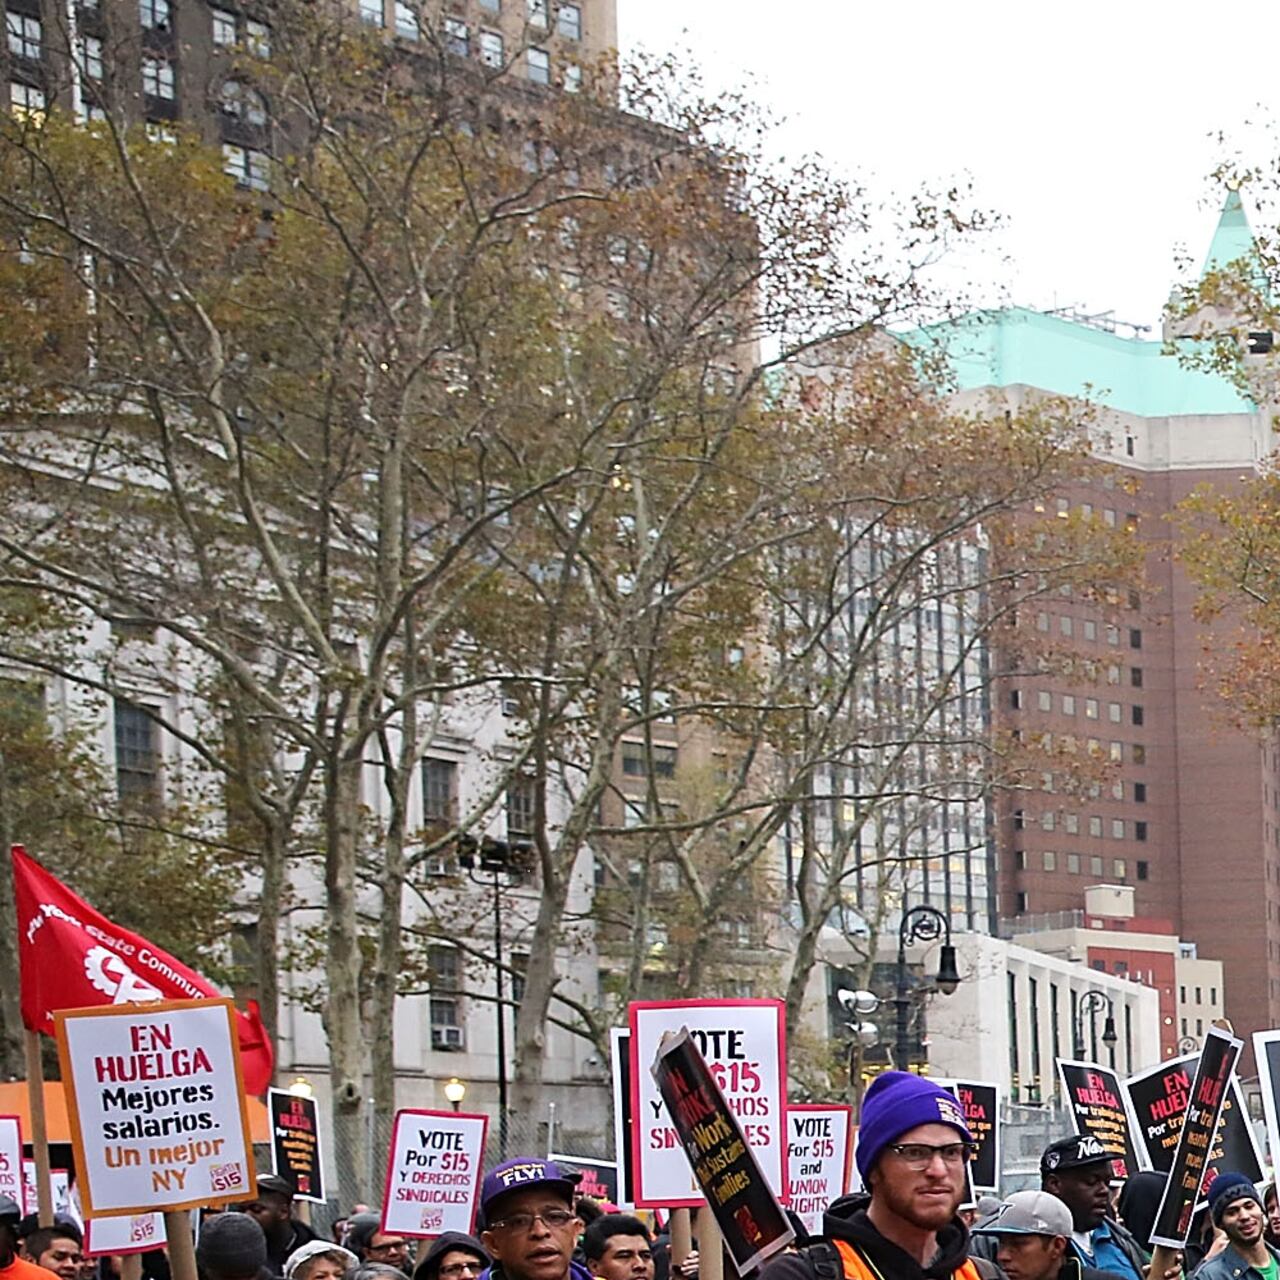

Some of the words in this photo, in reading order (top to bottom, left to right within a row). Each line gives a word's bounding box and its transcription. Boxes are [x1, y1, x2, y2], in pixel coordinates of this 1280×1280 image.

[131, 1023, 172, 1053] EN
[689, 1029, 745, 1060] OTE
[94, 1047, 213, 1083] HUELGA
[1088, 1073, 1104, 1090] EN
[1163, 1070, 1189, 1095] EN
[102, 1083, 214, 1114] Mejores
[1077, 1087, 1119, 1109] HUELGA
[650, 1100, 663, 1119] Y
[103, 1111, 220, 1140] salarios.
[793, 1118, 831, 1138] VOTE
[1147, 1123, 1167, 1139] Por
[419, 1130, 464, 1151] VOTE
[788, 1143, 809, 1157] For
[812, 1139, 833, 1157] $15
[105, 1146, 141, 1168] Un
[149, 1138, 225, 1165] mejor
[405, 1150, 437, 1167] Por
[441, 1153, 470, 1171] $15
[502, 1168, 546, 1187] FLY!
[800, 1160, 822, 1175] and
[152, 1169, 187, 1193] NY
[400, 1171, 408, 1182] Y
[412, 1172, 471, 1186] DERECHOS
[790, 1180, 828, 1196] UNION
[396, 1188, 469, 1204] SINDICALES
